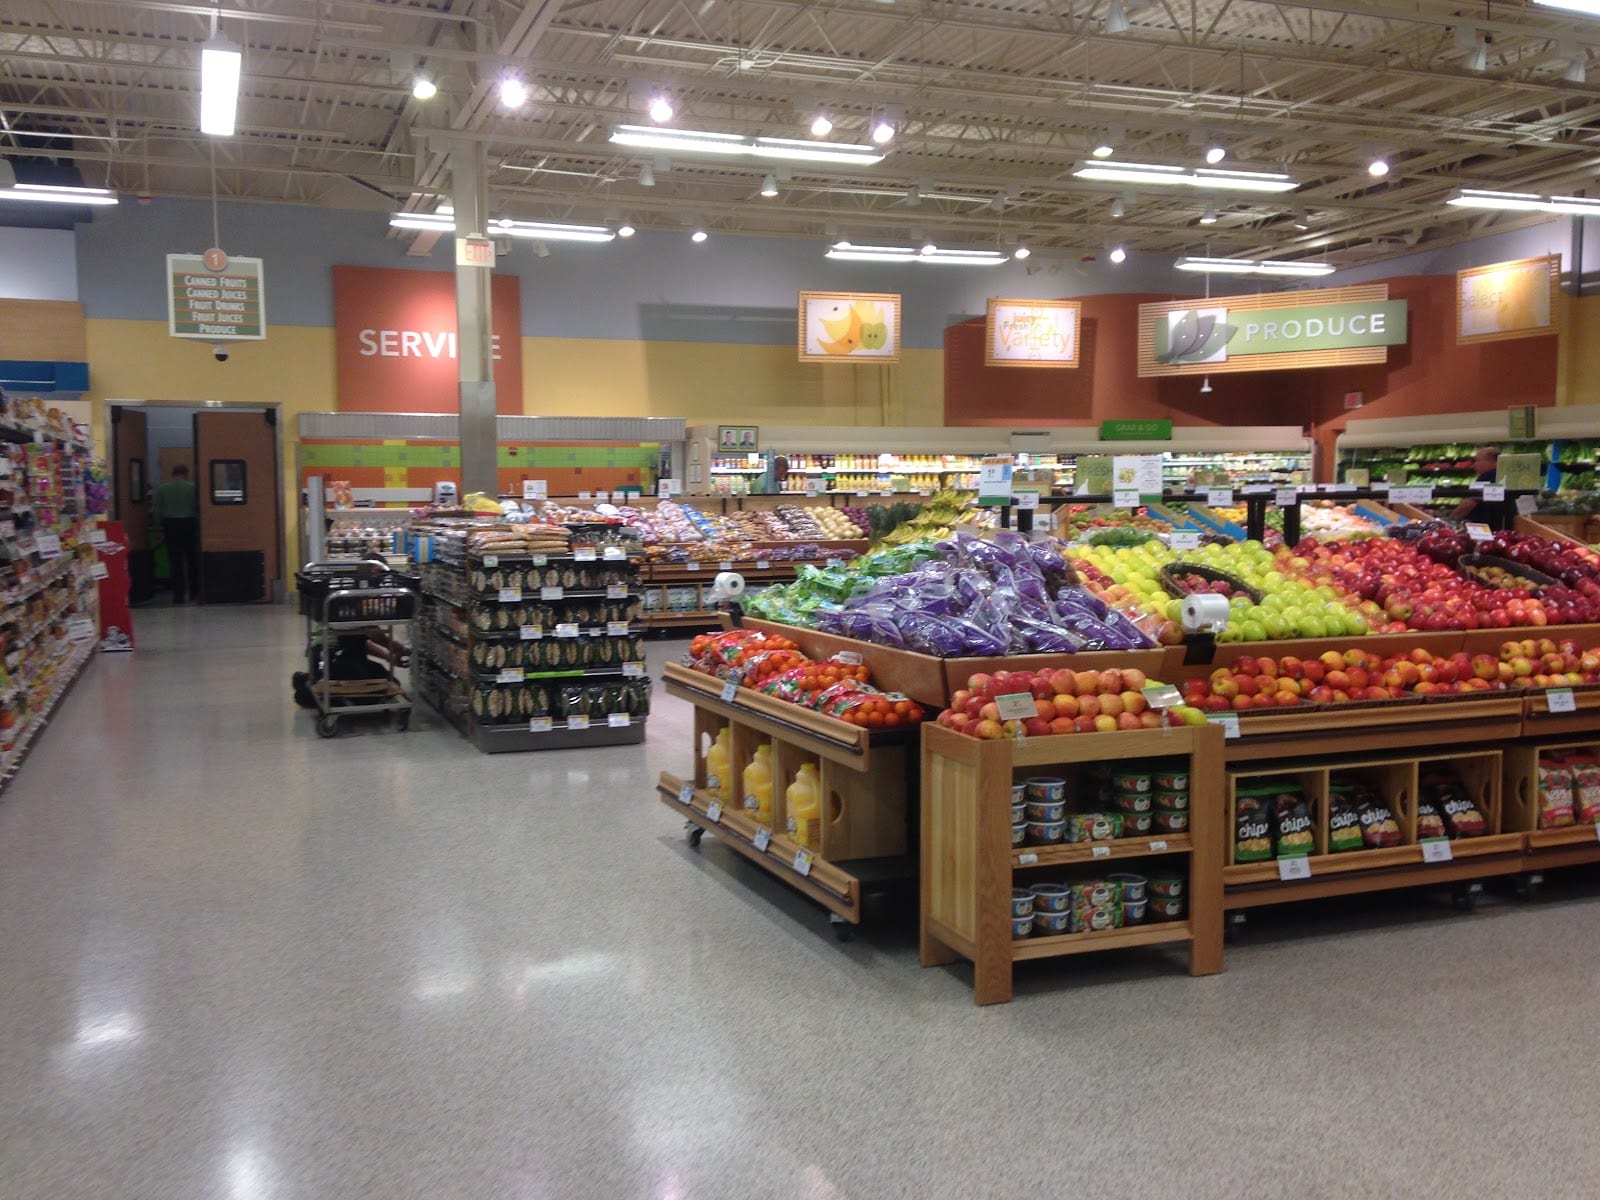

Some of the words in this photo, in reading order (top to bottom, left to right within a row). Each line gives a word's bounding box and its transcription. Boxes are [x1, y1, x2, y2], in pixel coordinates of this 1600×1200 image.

[211, 254, 218, 265] 1
[466, 243, 490, 262] EXIT
[1246, 313, 1386, 341] PRODUCE
[359, 328, 502, 360] SERVIE
[1000, 327, 1072, 354] Variety
[1280, 816, 1311, 834] chips
